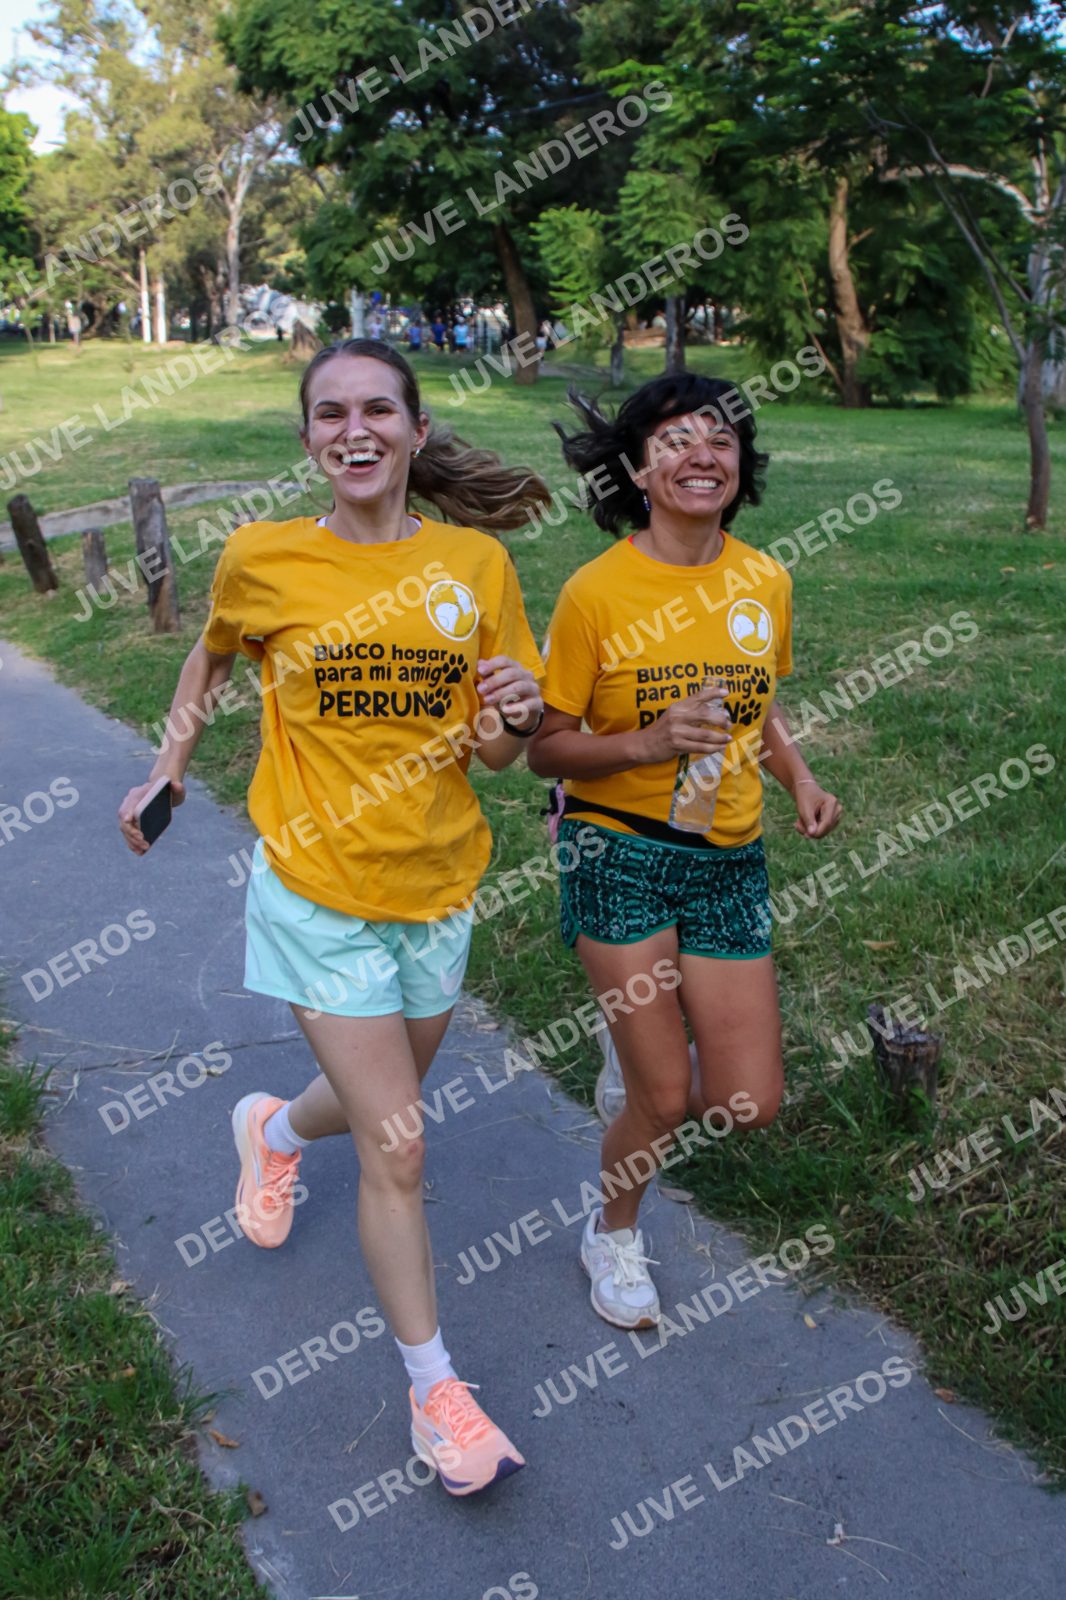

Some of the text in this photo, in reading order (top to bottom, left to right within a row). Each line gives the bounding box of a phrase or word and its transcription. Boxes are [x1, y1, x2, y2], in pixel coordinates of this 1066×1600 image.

[314, 643, 448, 663] BUSCO hogar
[314, 665, 362, 688] para
[369, 662, 391, 681] mi
[636, 662, 751, 684] BUSCO hogar
[319, 690, 429, 717] PERRUN
[636, 684, 681, 708] para
